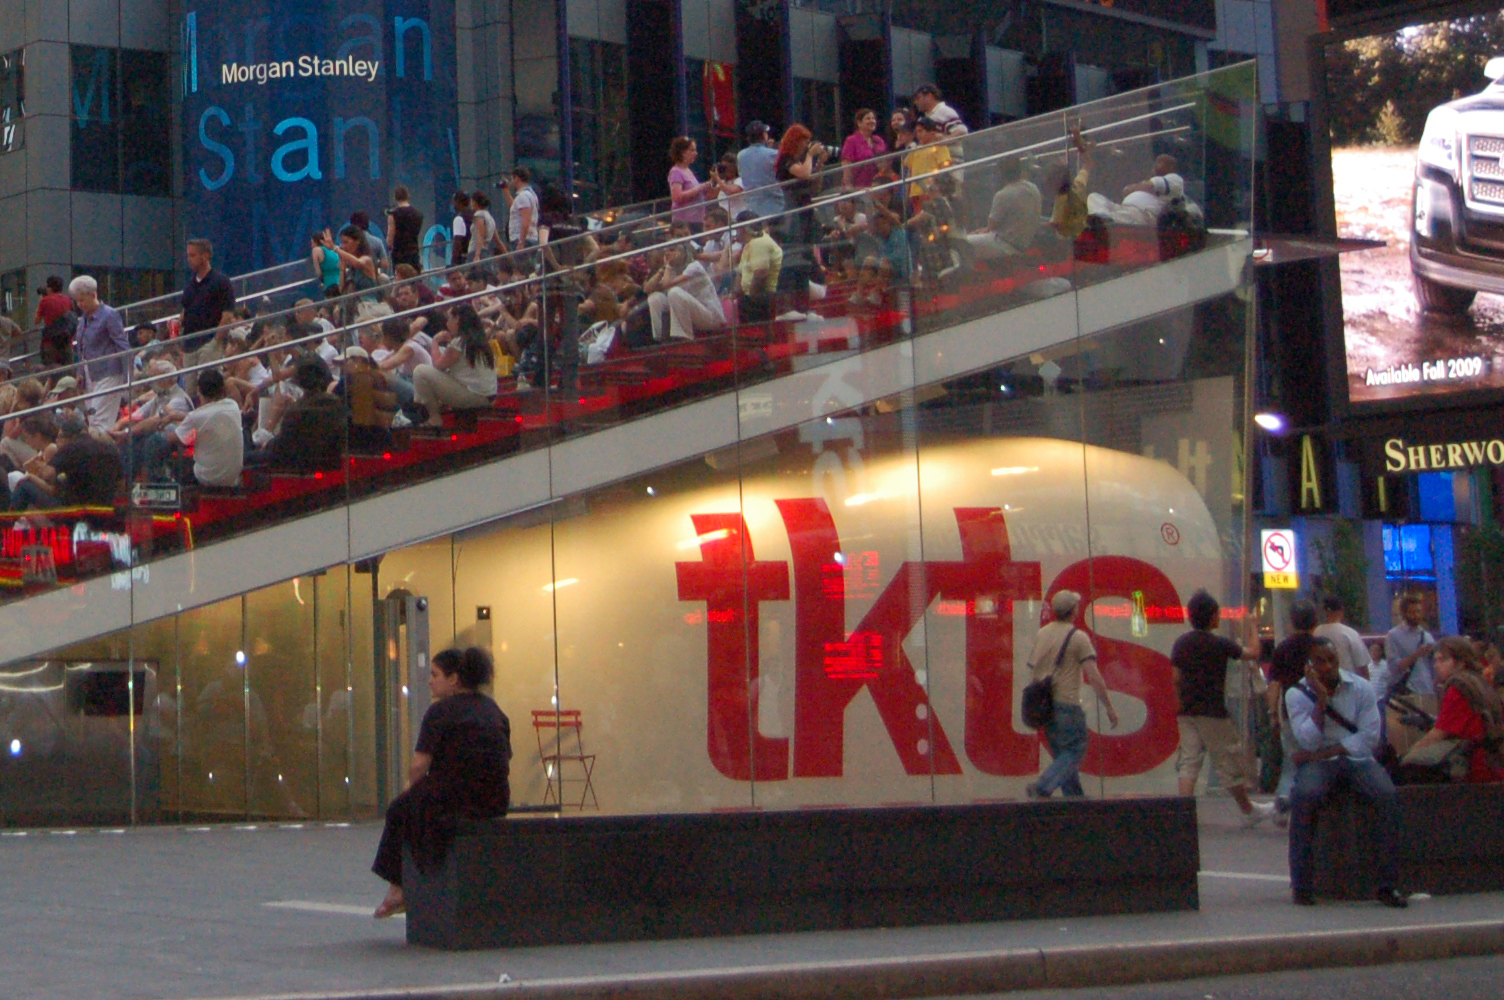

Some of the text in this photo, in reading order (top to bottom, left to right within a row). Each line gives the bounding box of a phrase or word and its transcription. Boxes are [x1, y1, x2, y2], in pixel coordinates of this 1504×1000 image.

[221, 55, 379, 85] Morgan Stanley
[1365, 356, 1482, 386] Available Fall 2009
[1270, 575, 1289, 585] NEW
[675, 497, 1185, 782] tkts
